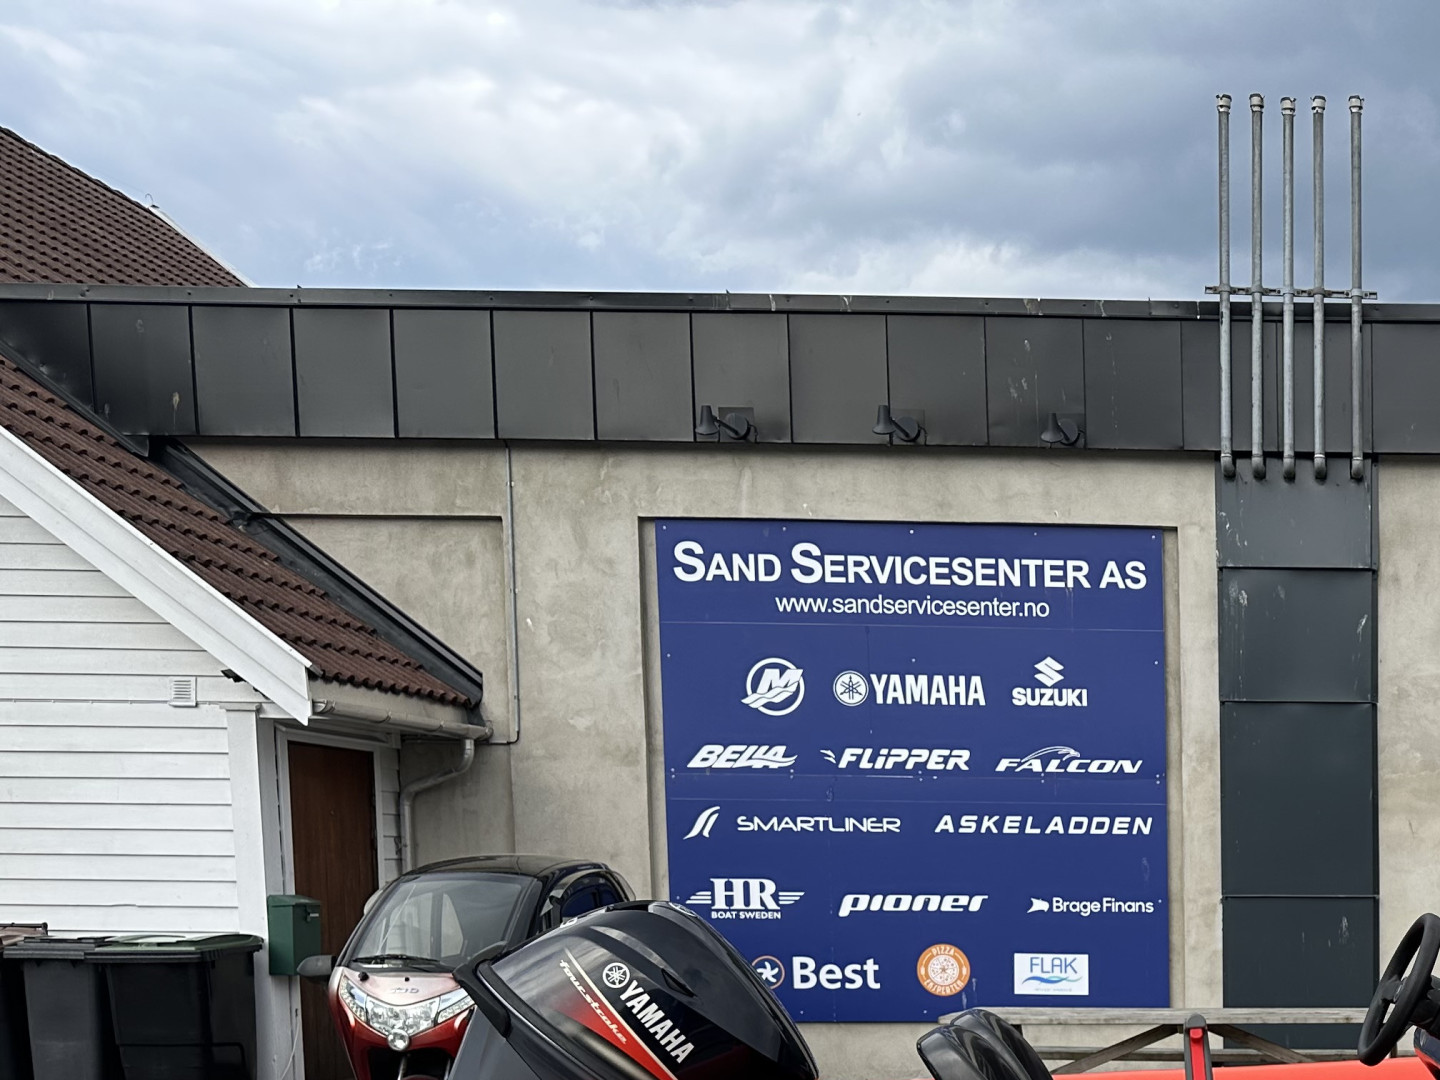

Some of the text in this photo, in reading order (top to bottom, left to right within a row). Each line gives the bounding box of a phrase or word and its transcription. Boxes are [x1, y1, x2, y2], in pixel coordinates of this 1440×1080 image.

[673, 540, 1147, 590] SAND SERVICESENTER AS
[775, 594, 1050, 618] www.sandservicesenter.no
[870, 673, 986, 706] YAMAHA
[1012, 687, 1088, 707] SUZUKI
[686, 744, 798, 769] BELLA
[995, 758, 1143, 774] FALCON
[736, 815, 901, 834] SMARTLINER
[934, 814, 1153, 835] ASKELADDEN
[710, 878, 781, 910] HR
[711, 911, 782, 920] BOAT SWEDEN
[838, 893, 989, 918] pioner
[1052, 896, 1155, 917] Brage Finans
[931, 946, 955, 956] PIZZA
[792, 956, 881, 990] Best
[1030, 956, 1078, 974] FLAK
[619, 979, 695, 1064] YAMAHA
